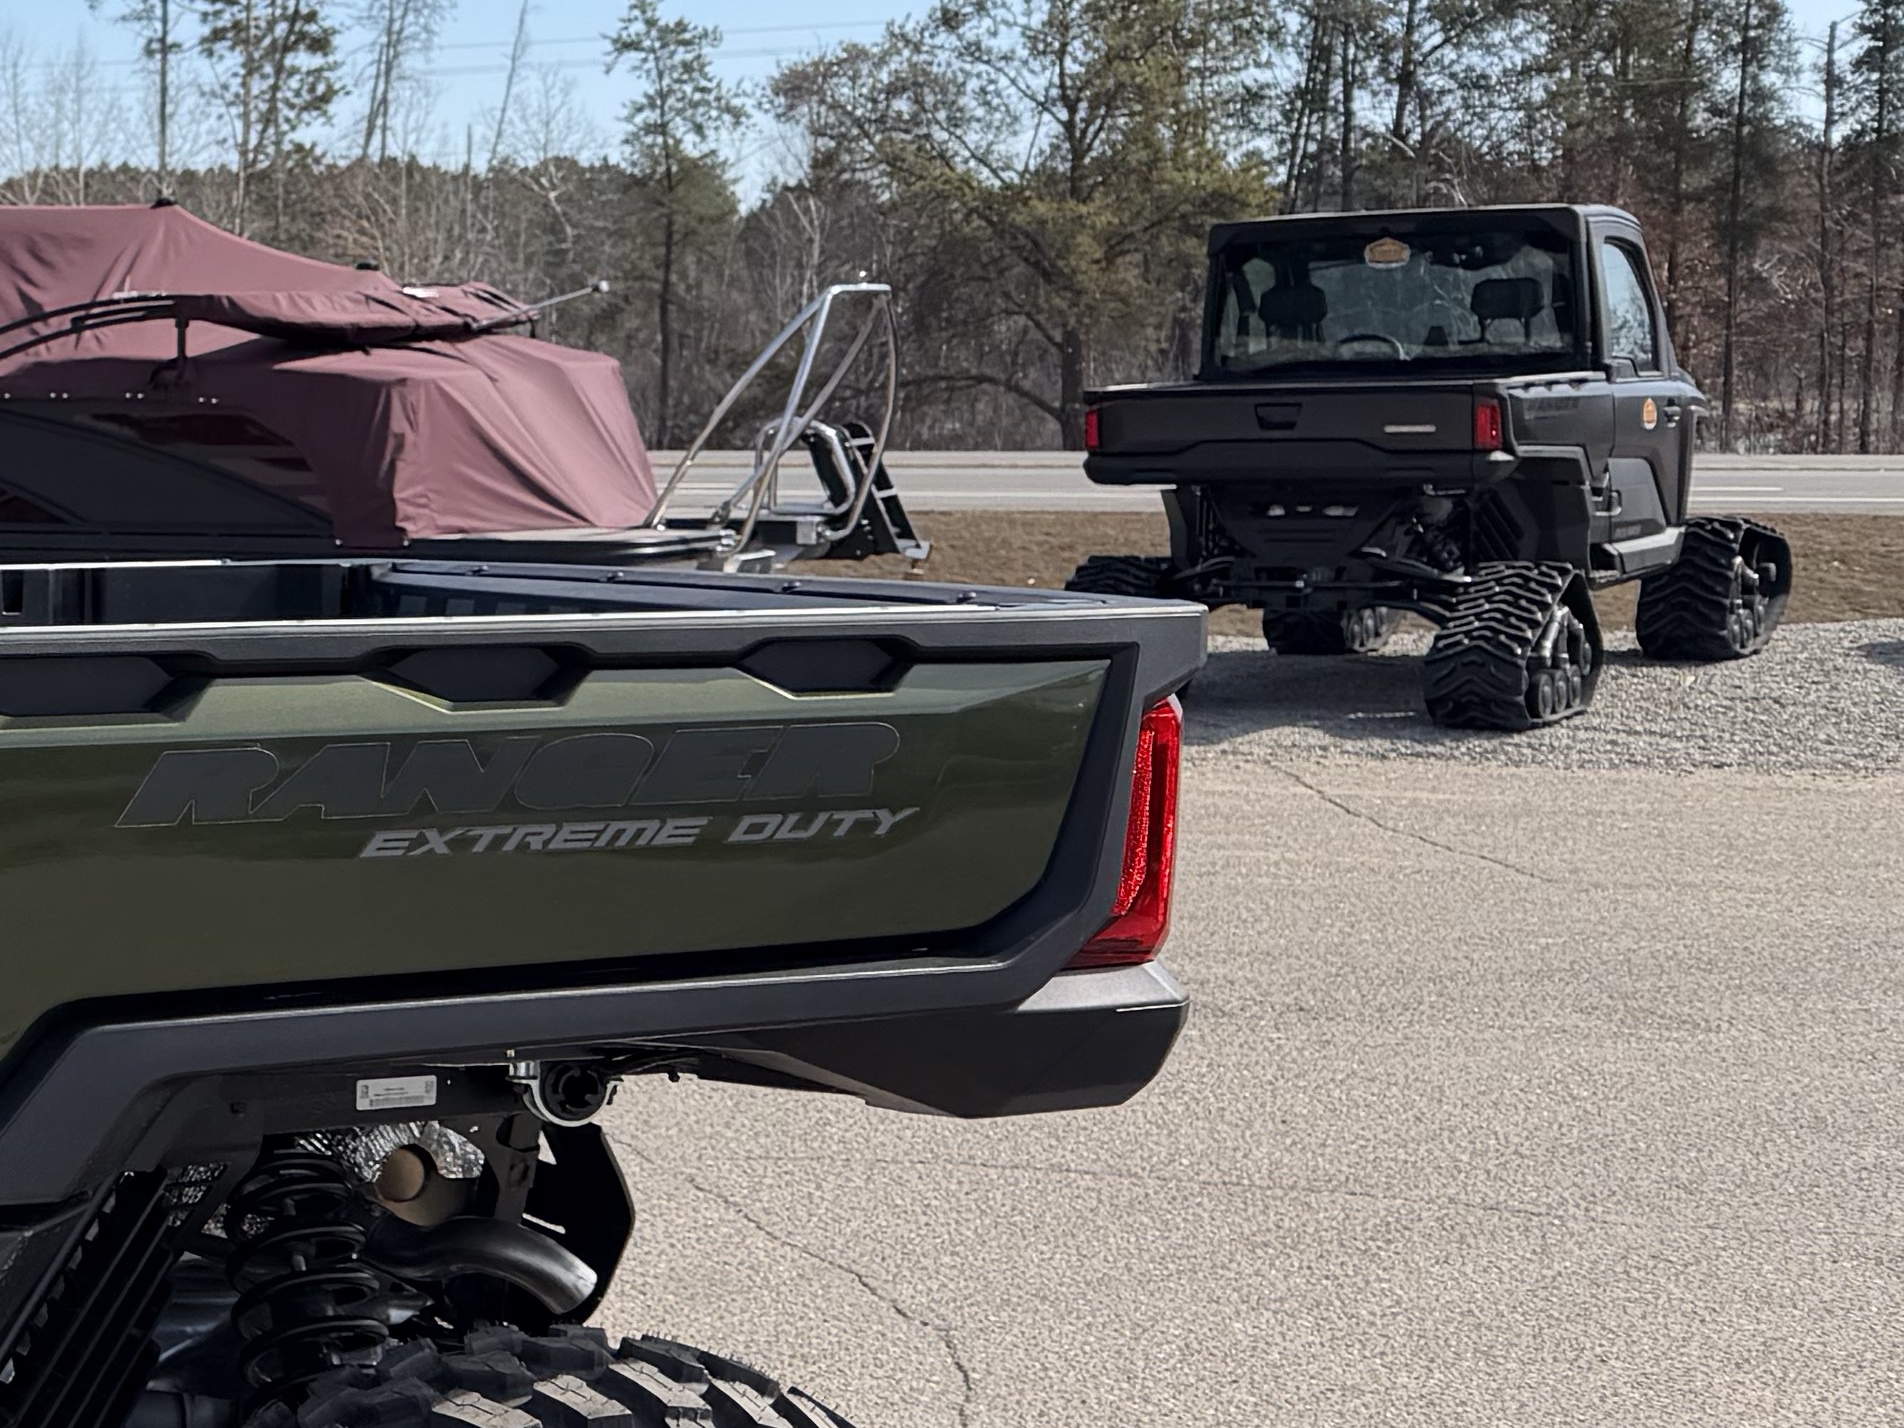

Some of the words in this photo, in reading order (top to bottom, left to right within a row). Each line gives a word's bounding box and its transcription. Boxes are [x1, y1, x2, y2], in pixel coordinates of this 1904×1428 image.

[114, 721, 900, 828] RANGER
[359, 815, 713, 859] EXTREME
[726, 806, 921, 842] DUTY
